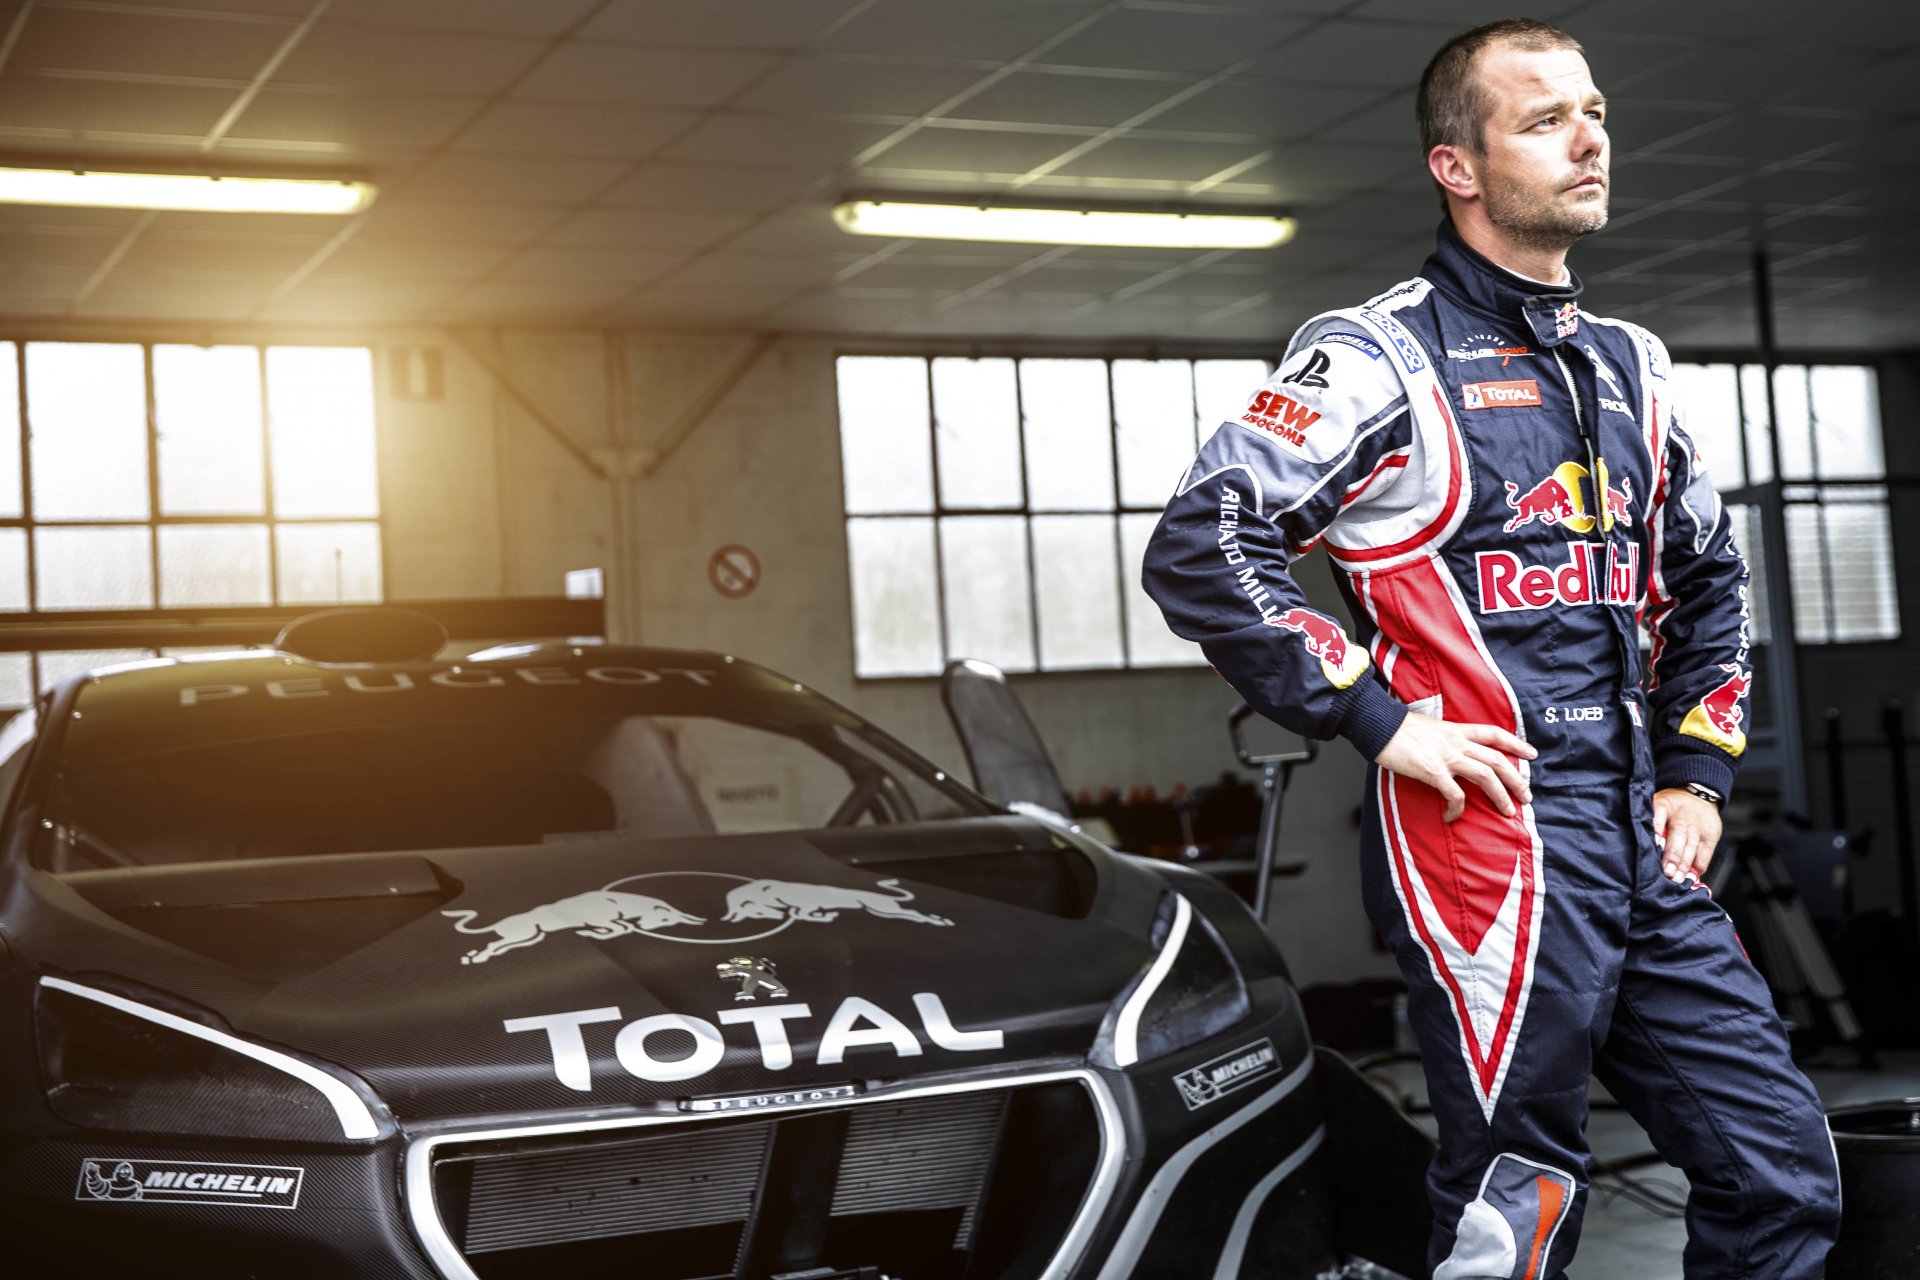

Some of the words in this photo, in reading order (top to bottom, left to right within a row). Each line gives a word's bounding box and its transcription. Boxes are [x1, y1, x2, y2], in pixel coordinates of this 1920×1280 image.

[1323, 334, 1382, 356] MICHELIN
[1482, 387, 1537, 401] TOTAL
[1249, 390, 1321, 432] SEW
[1477, 542, 1591, 612] Red
[180, 665, 715, 706] PEUGEOT
[1545, 707, 1559, 723] S.
[1564, 706, 1604, 721] LOEB
[503, 993, 1004, 1091] TOTAL
[144, 1171, 295, 1194] MICHELIN
